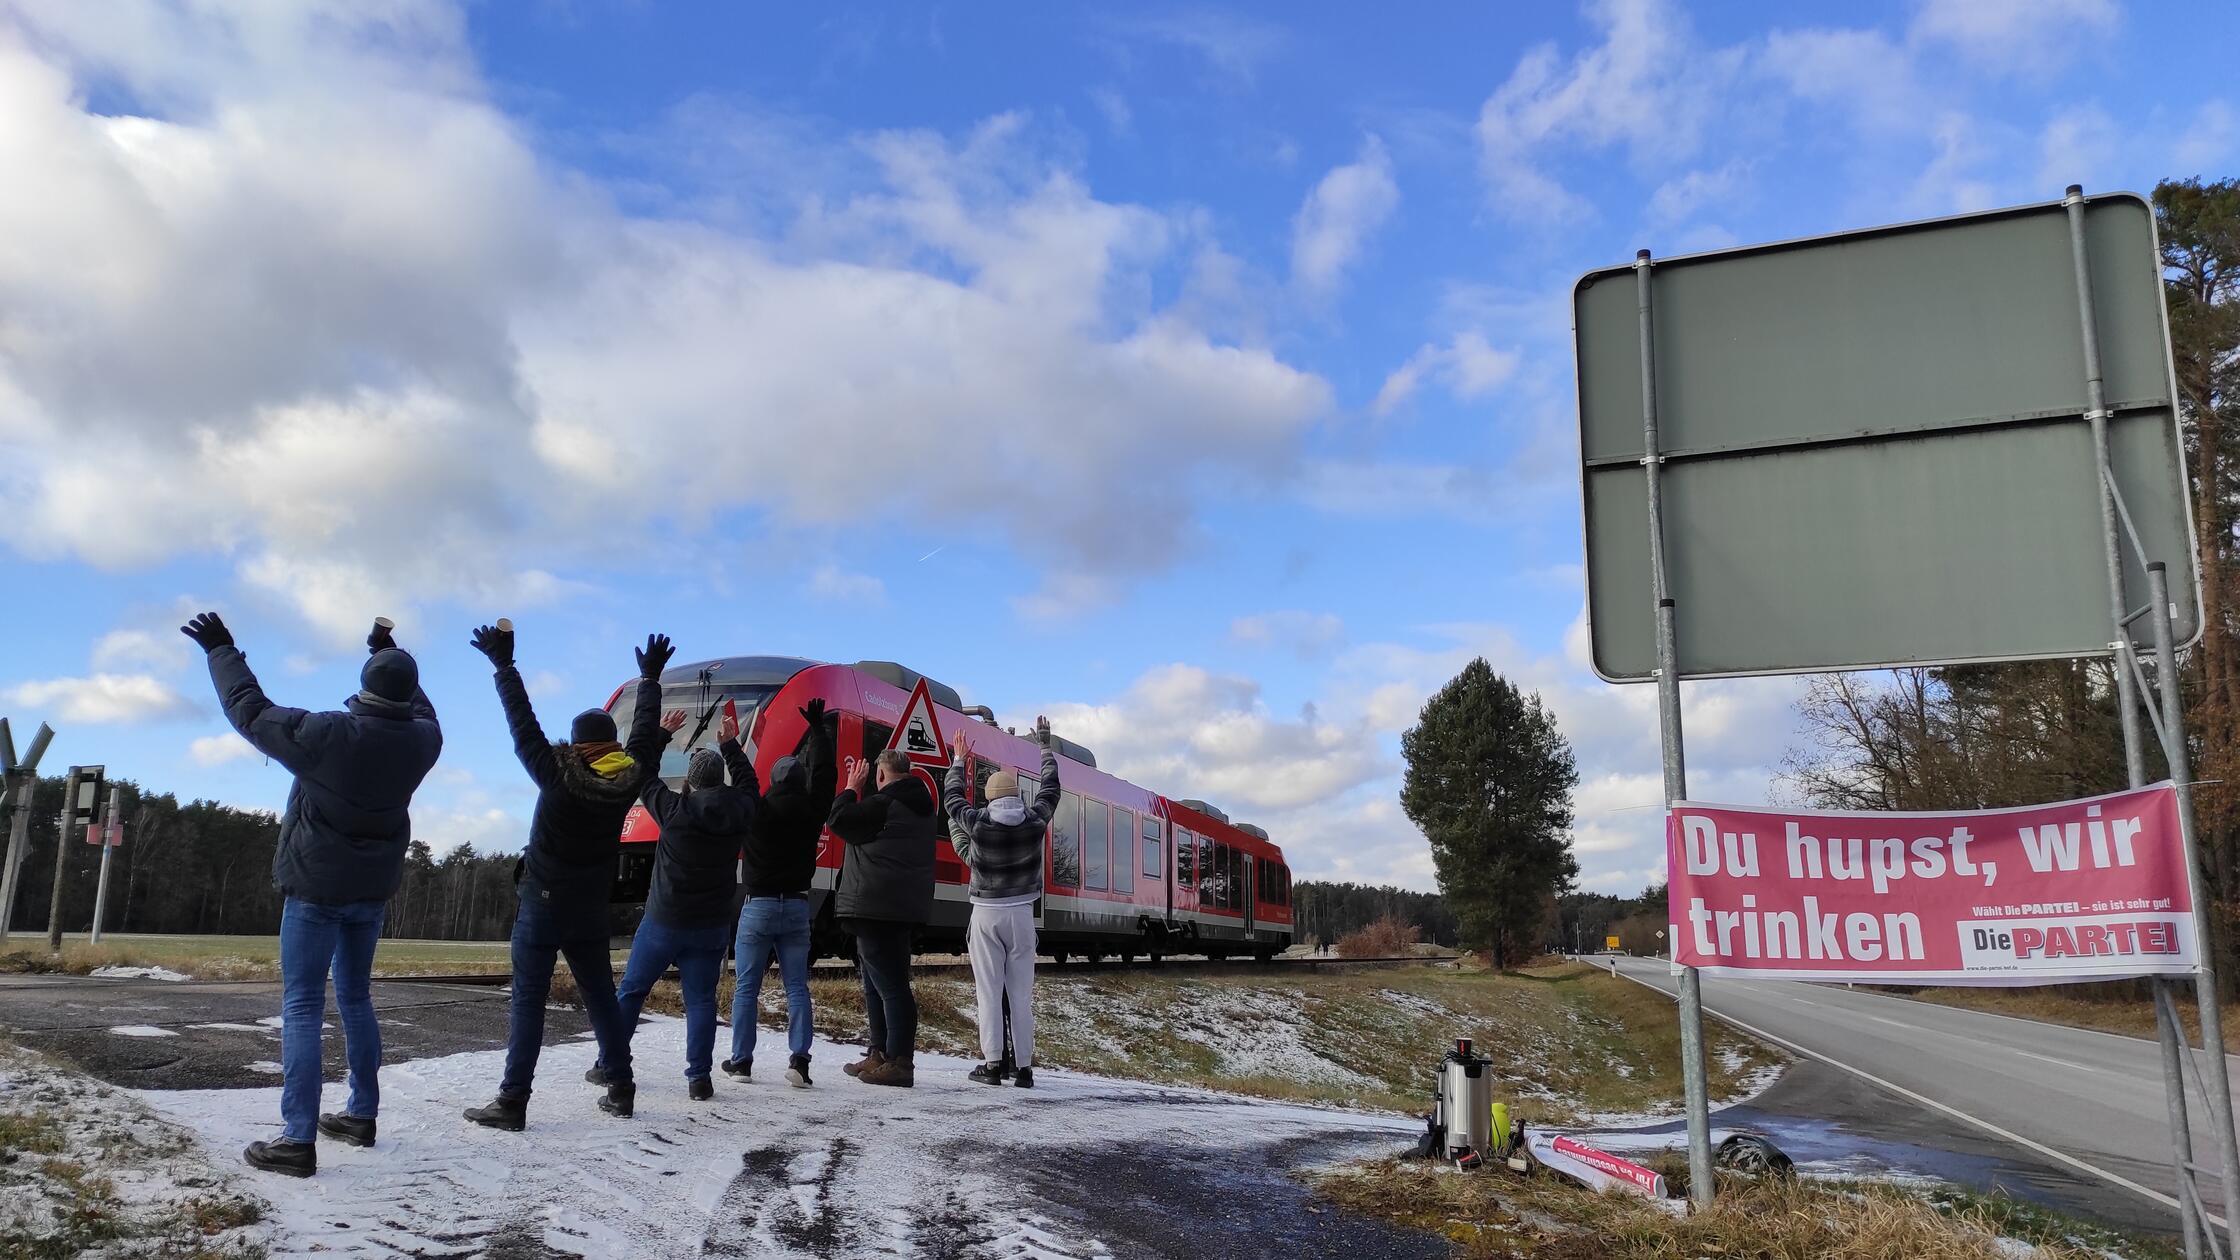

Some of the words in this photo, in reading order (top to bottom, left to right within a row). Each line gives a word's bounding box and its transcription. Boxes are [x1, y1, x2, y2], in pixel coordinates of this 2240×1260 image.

[1682, 815, 1760, 878] Du
[1785, 821, 1997, 894] hupst,
[2019, 804, 2141, 873] wir
[1689, 894, 1925, 961] trinken
[1972, 906, 2002, 917] Wählt
[2092, 900, 2108, 912] sie
[2110, 899, 2125, 911] ist
[2127, 898, 2150, 909] sehr
[2153, 897, 2171, 910] gut!
